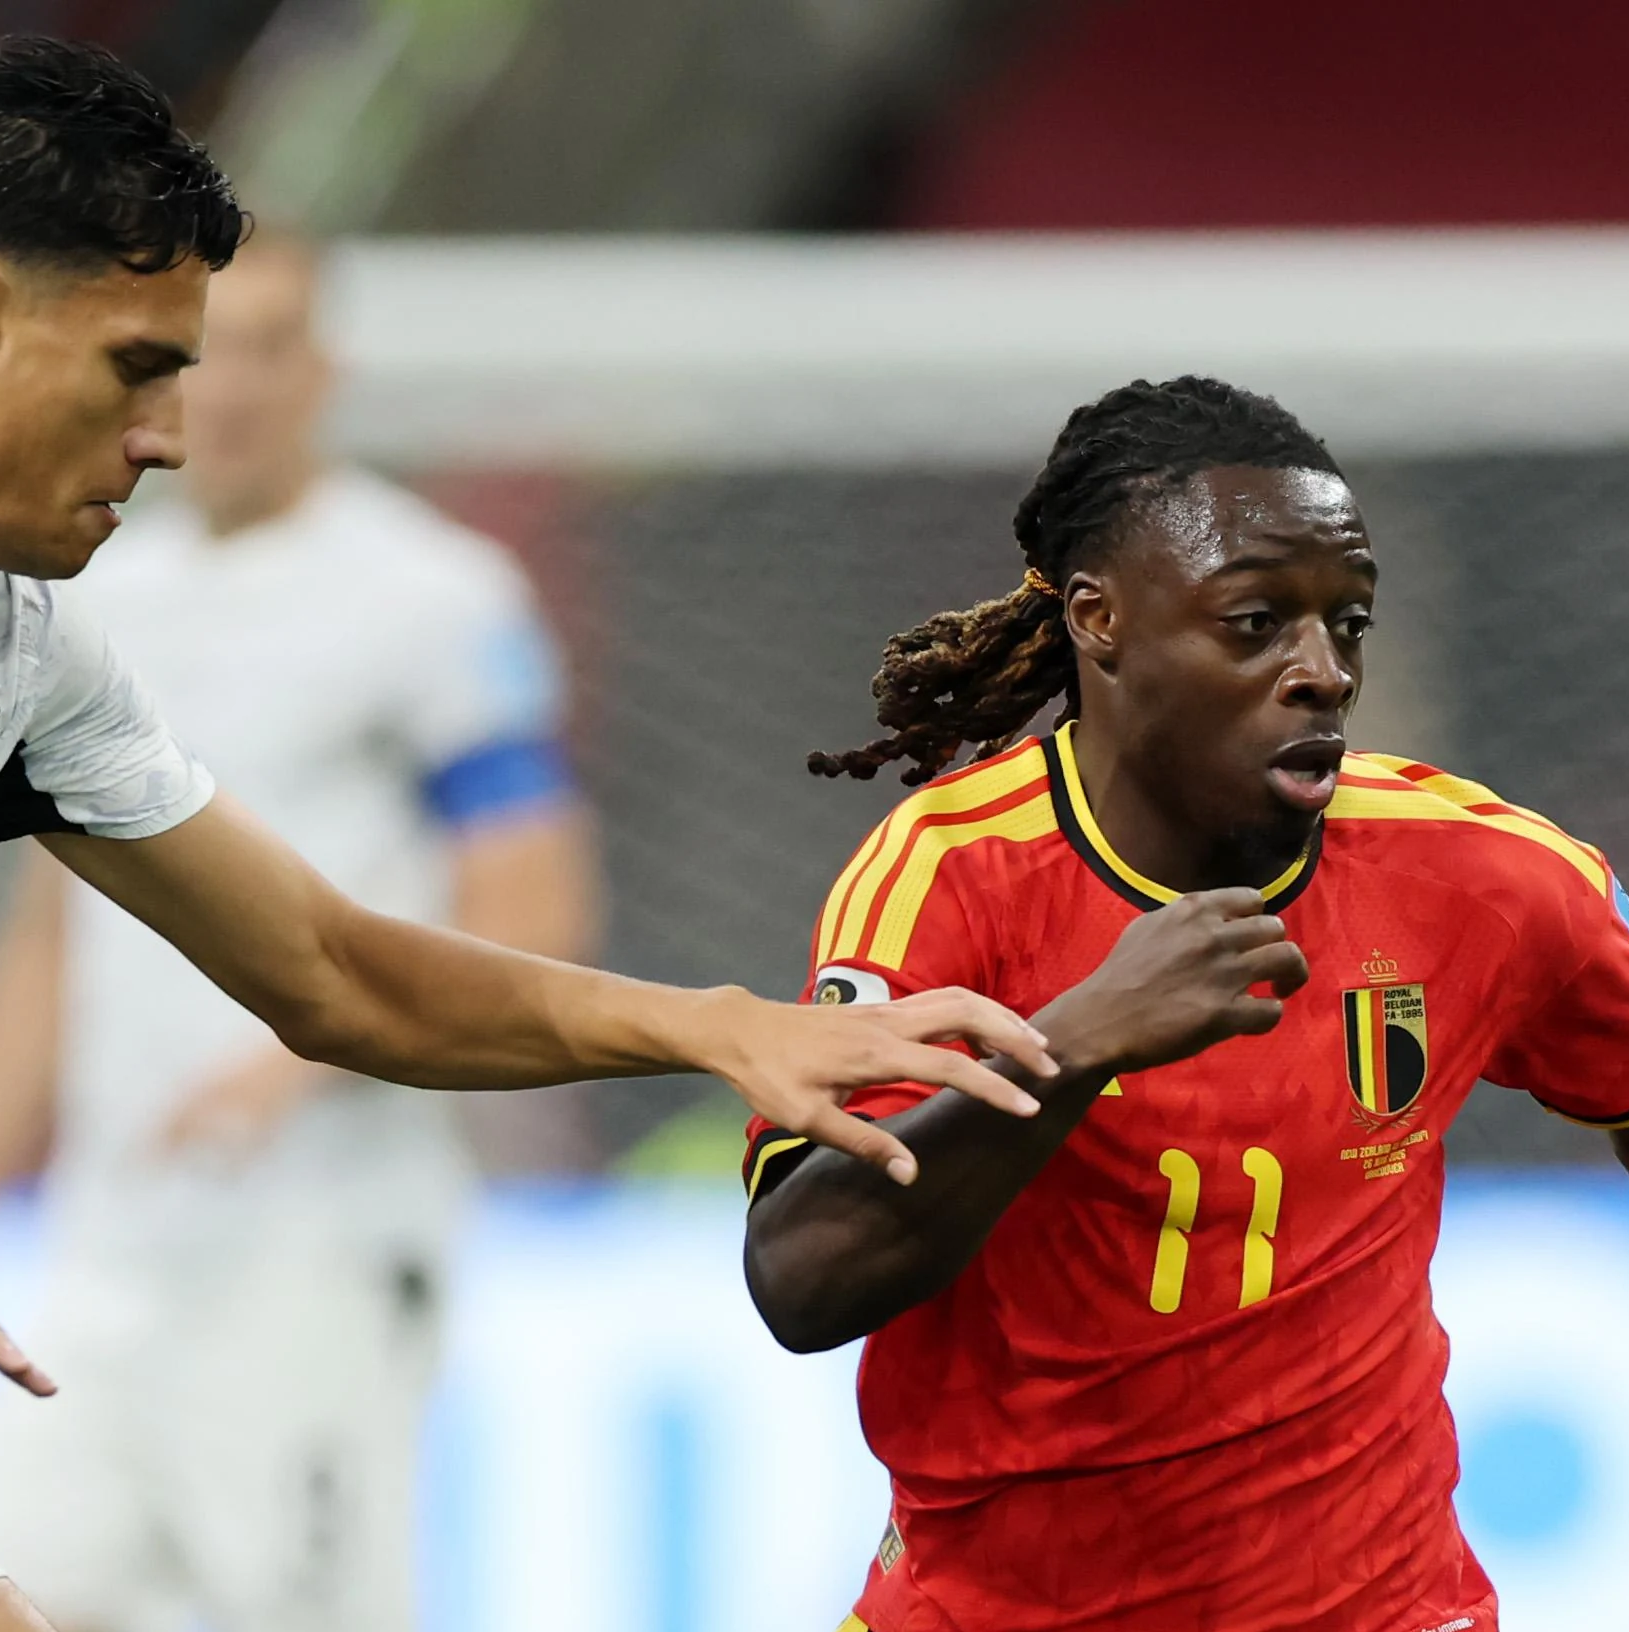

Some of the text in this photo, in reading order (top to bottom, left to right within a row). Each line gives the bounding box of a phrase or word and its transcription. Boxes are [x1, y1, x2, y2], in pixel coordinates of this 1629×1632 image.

[1384, 989, 1412, 999] ROYAL
[1384, 998, 1422, 1010] BELGIAN
[1149, 1146, 1283, 1313] 11
